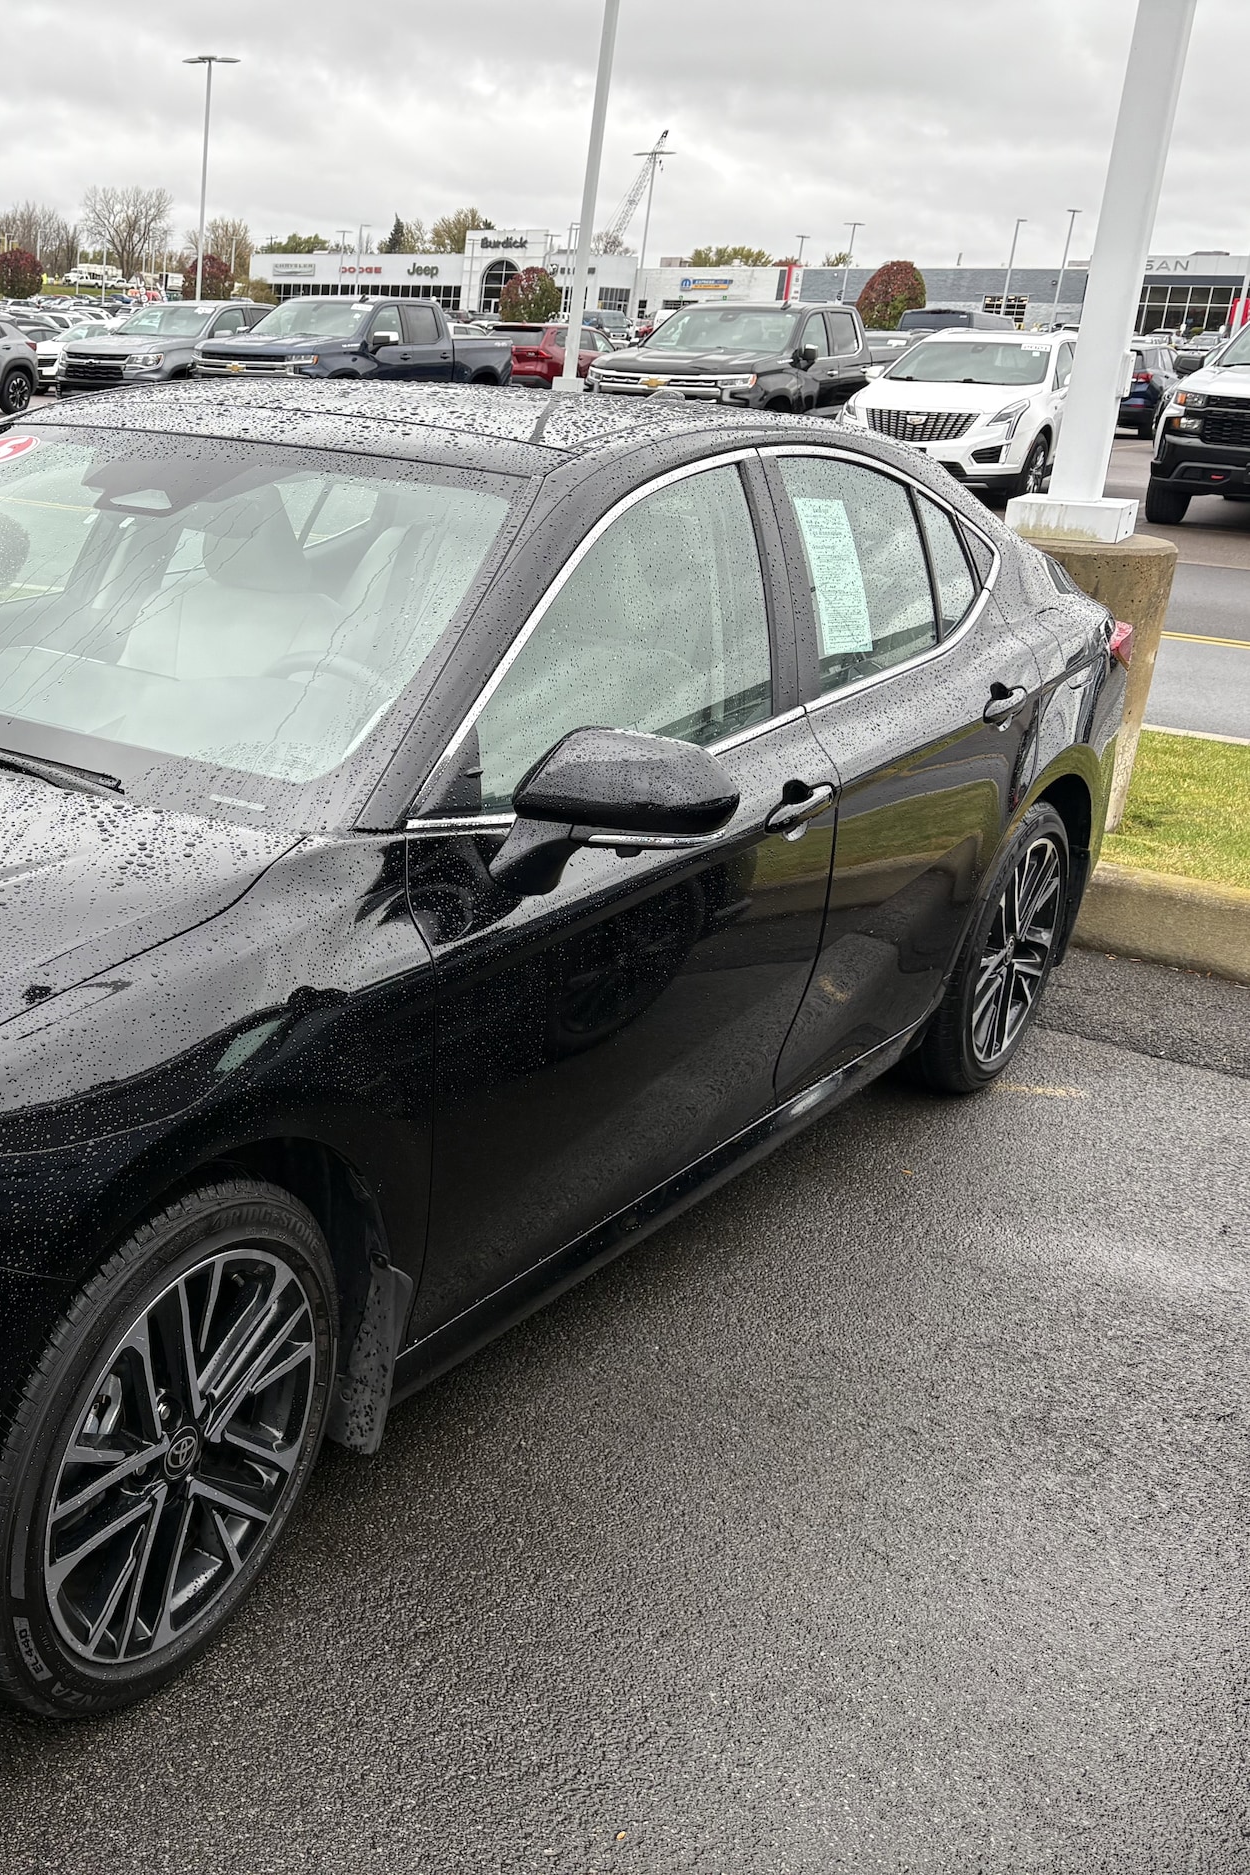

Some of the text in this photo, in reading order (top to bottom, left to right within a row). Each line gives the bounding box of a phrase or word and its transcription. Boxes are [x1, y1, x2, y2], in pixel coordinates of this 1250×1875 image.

[480, 236, 528, 249] Burdick
[339, 266, 382, 274] DODGE
[407, 262, 439, 278] Jeep
[1145, 260, 1190, 272] SAN
[211, 1206, 321, 1254] BRIDGESTONE
[18, 1628, 44, 1675] EL440
